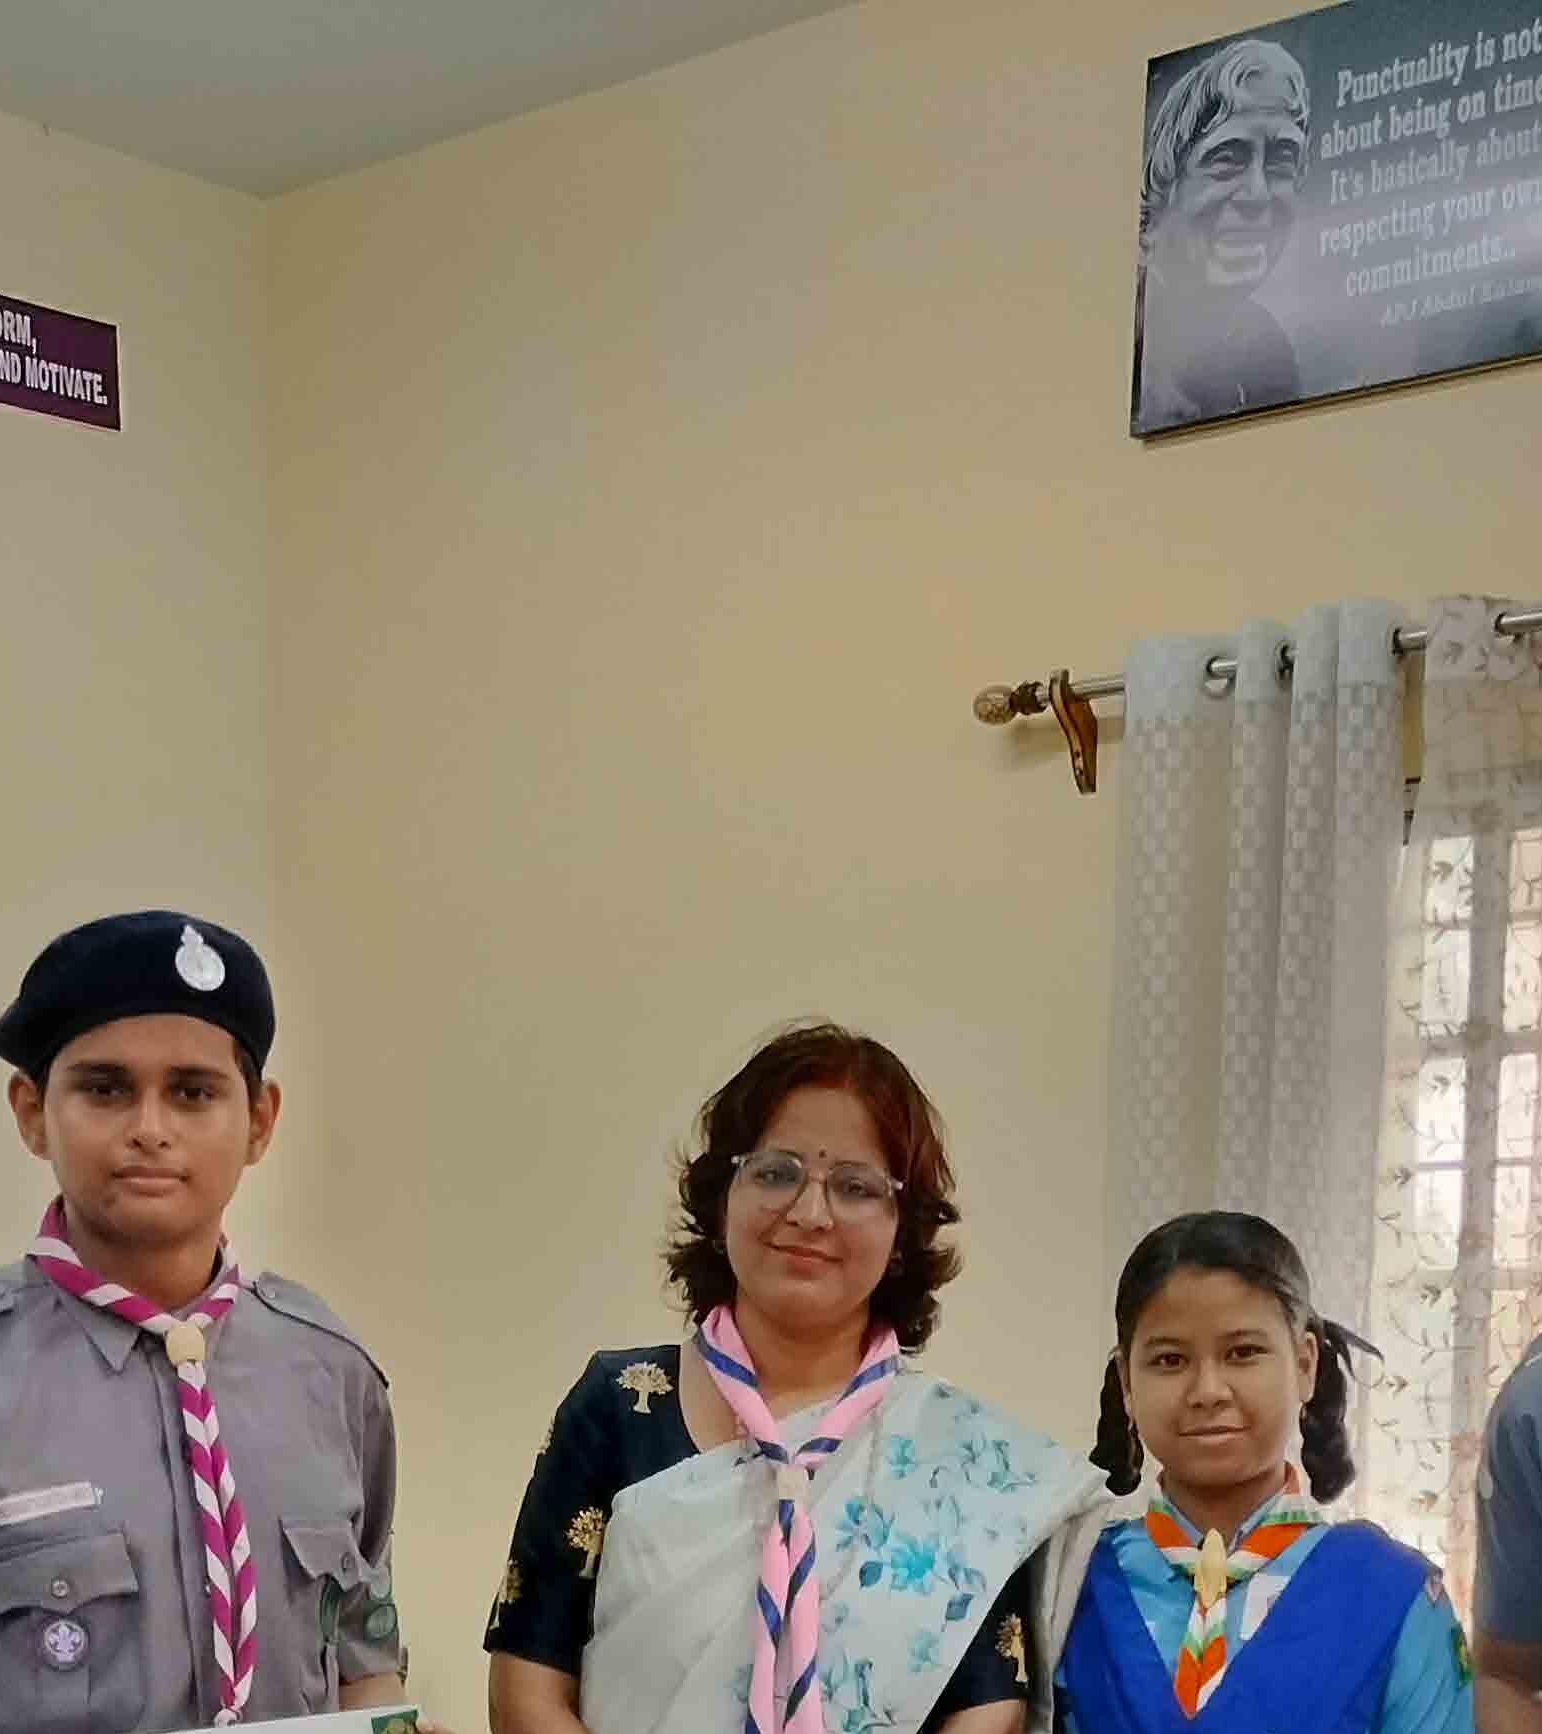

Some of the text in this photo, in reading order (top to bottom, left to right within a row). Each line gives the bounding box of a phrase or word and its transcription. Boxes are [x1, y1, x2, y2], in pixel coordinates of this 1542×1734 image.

[1336, 17, 1542, 107] Punctuality is not
[1320, 116, 1382, 158] about
[1389, 98, 1450, 139] being
[1457, 94, 1486, 122] on
[1330, 120, 1541, 205] It's basically about
[1319, 202, 1435, 258] respecting
[1442, 192, 1492, 237] your
[25, 359, 107, 405] MOTIVATE.
